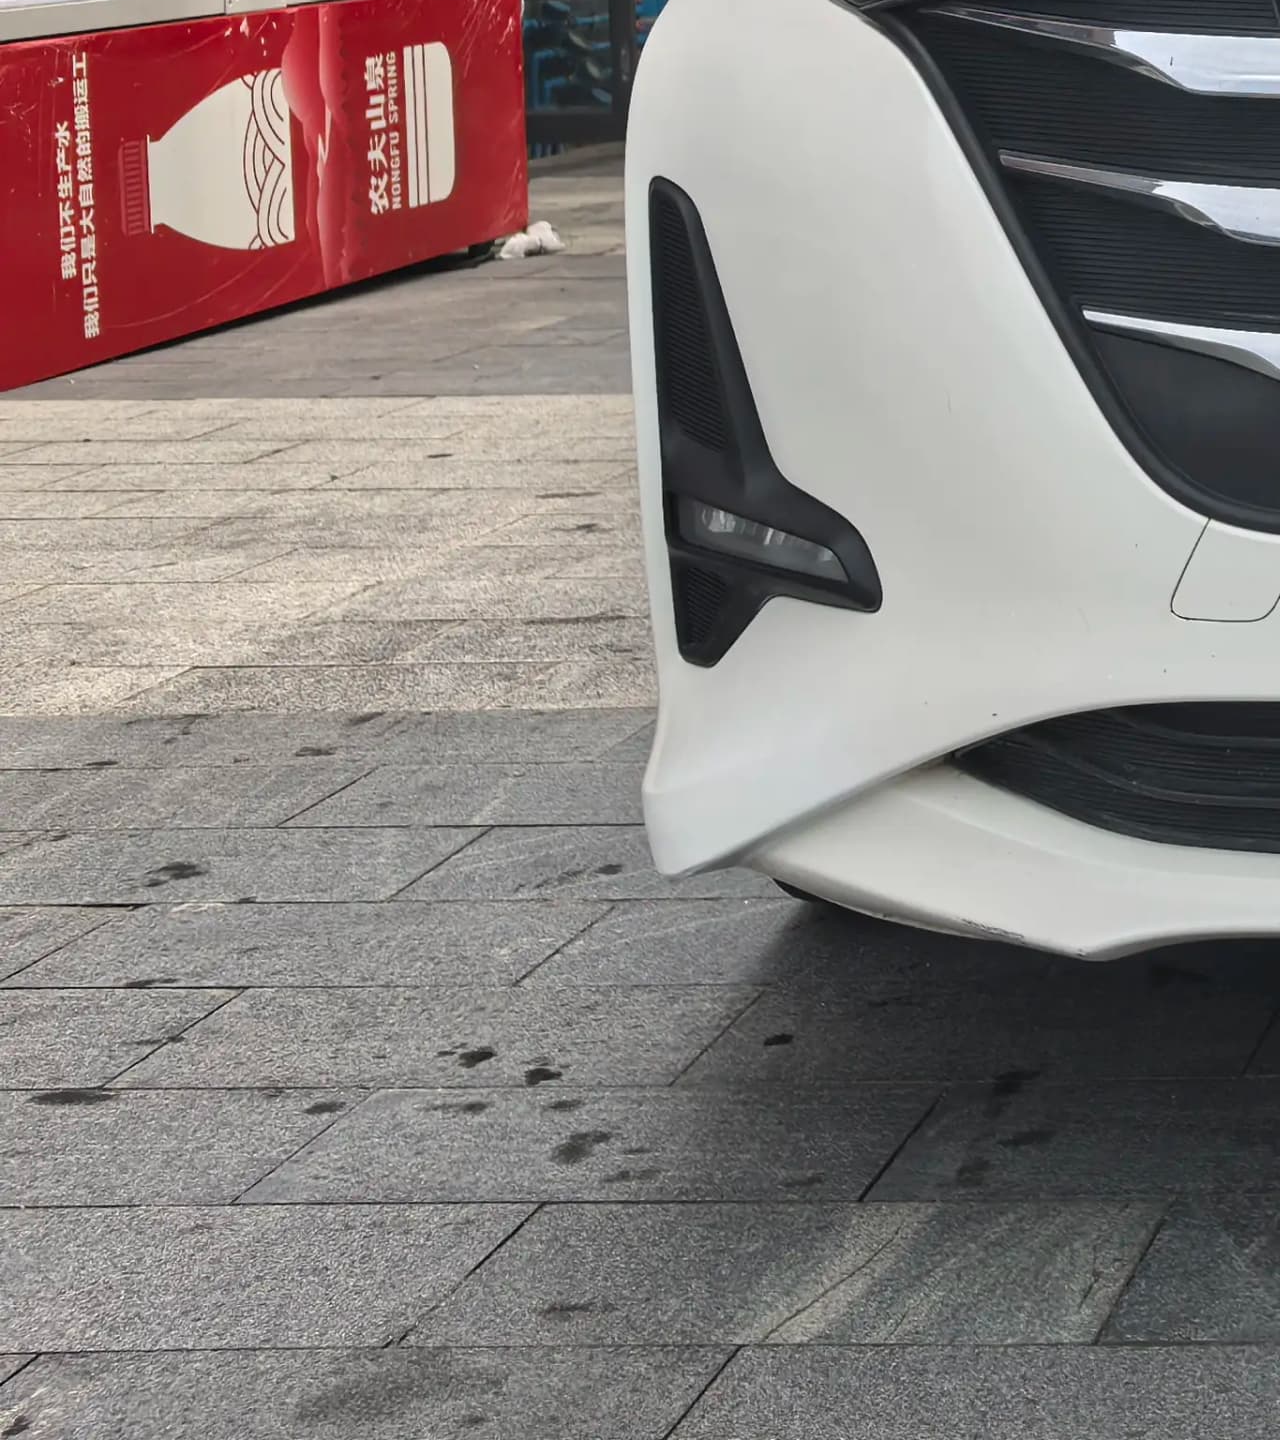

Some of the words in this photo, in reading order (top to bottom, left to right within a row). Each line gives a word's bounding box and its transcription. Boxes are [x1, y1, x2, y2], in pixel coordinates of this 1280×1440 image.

[364, 54, 391, 214] 农夫山泉
[385, 51, 398, 124] SPRING
[54, 121, 77, 279] 我们不生产水
[73, 53, 100, 338] 我们只是大自然的搬运工
[389, 129, 402, 209] NONGFU
